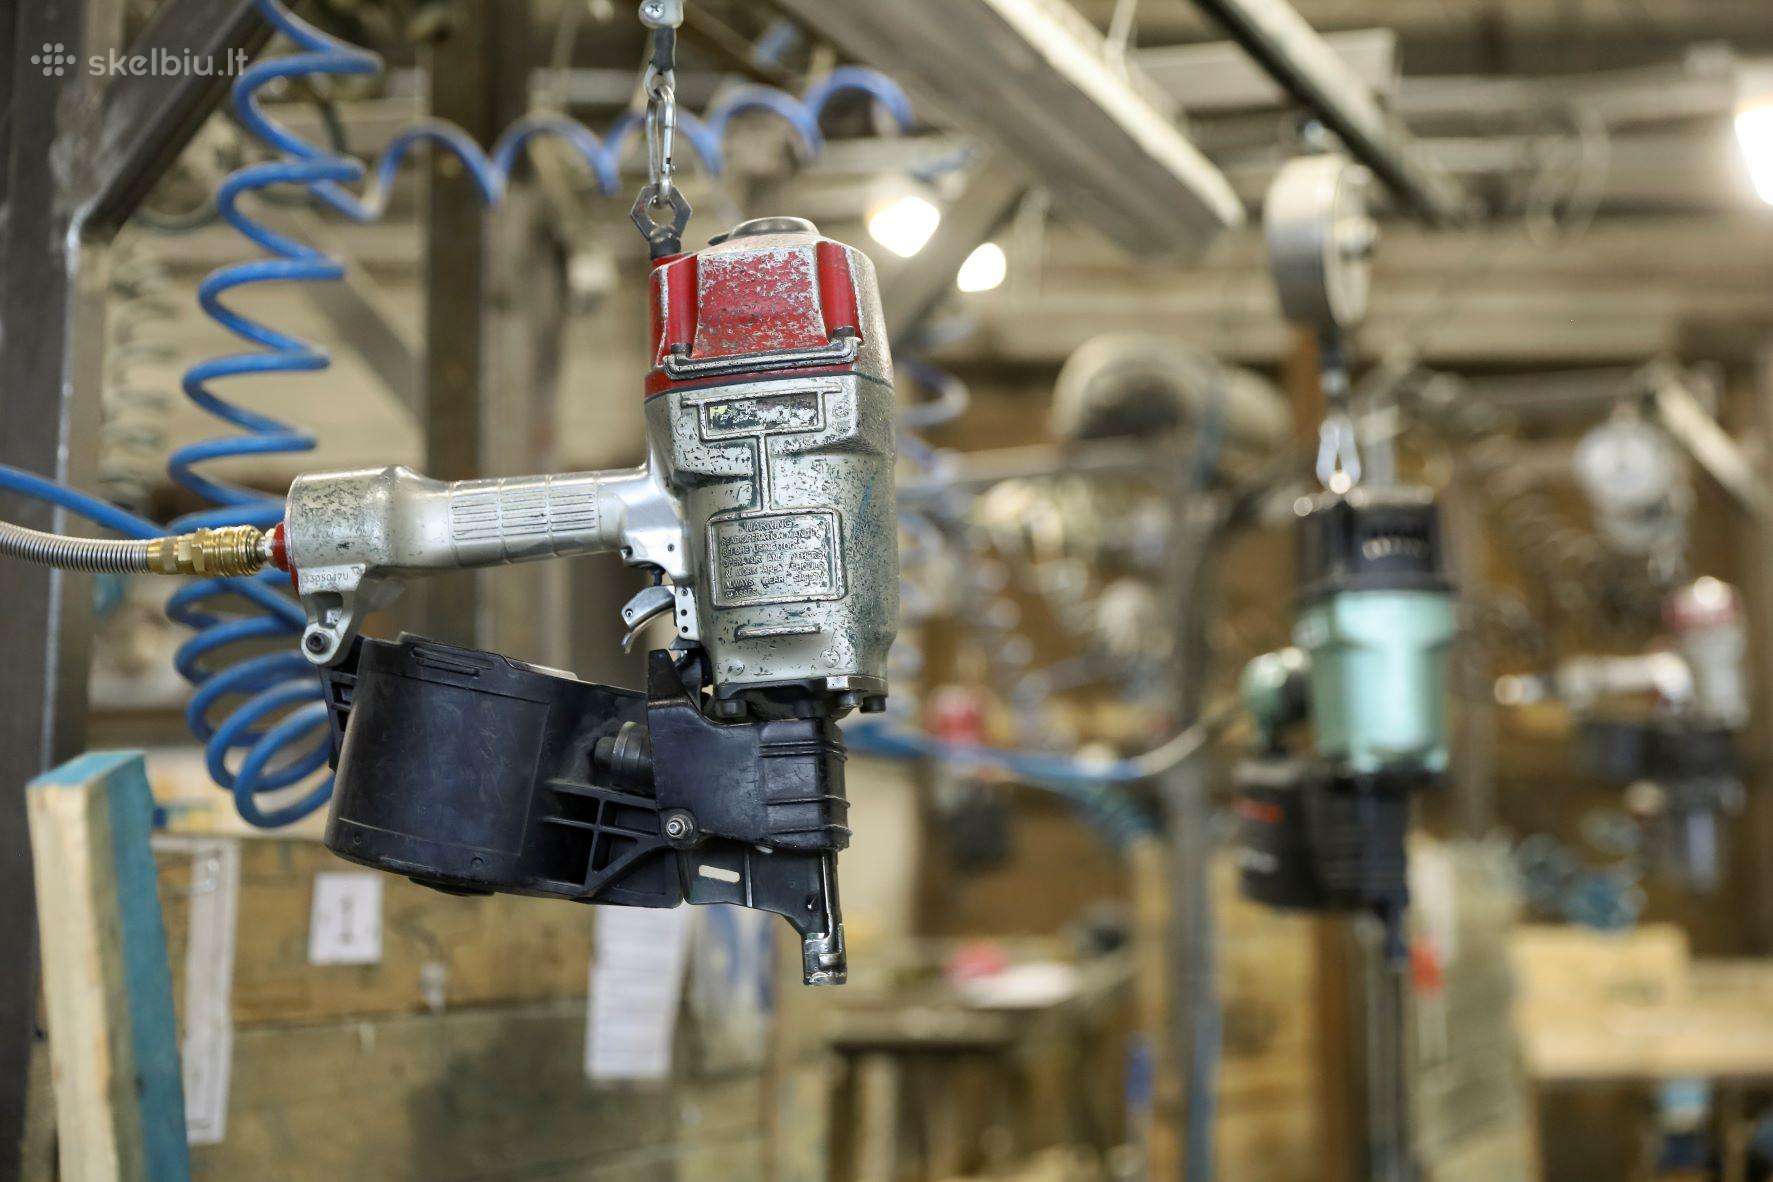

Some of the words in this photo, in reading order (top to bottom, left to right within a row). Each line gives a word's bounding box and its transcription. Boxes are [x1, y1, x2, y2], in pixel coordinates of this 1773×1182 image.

[742, 518, 794, 532] WARNING
[767, 553, 784, 562] AND
[761, 563, 784, 573] AREA
[723, 579, 755, 589] ALWAYS
